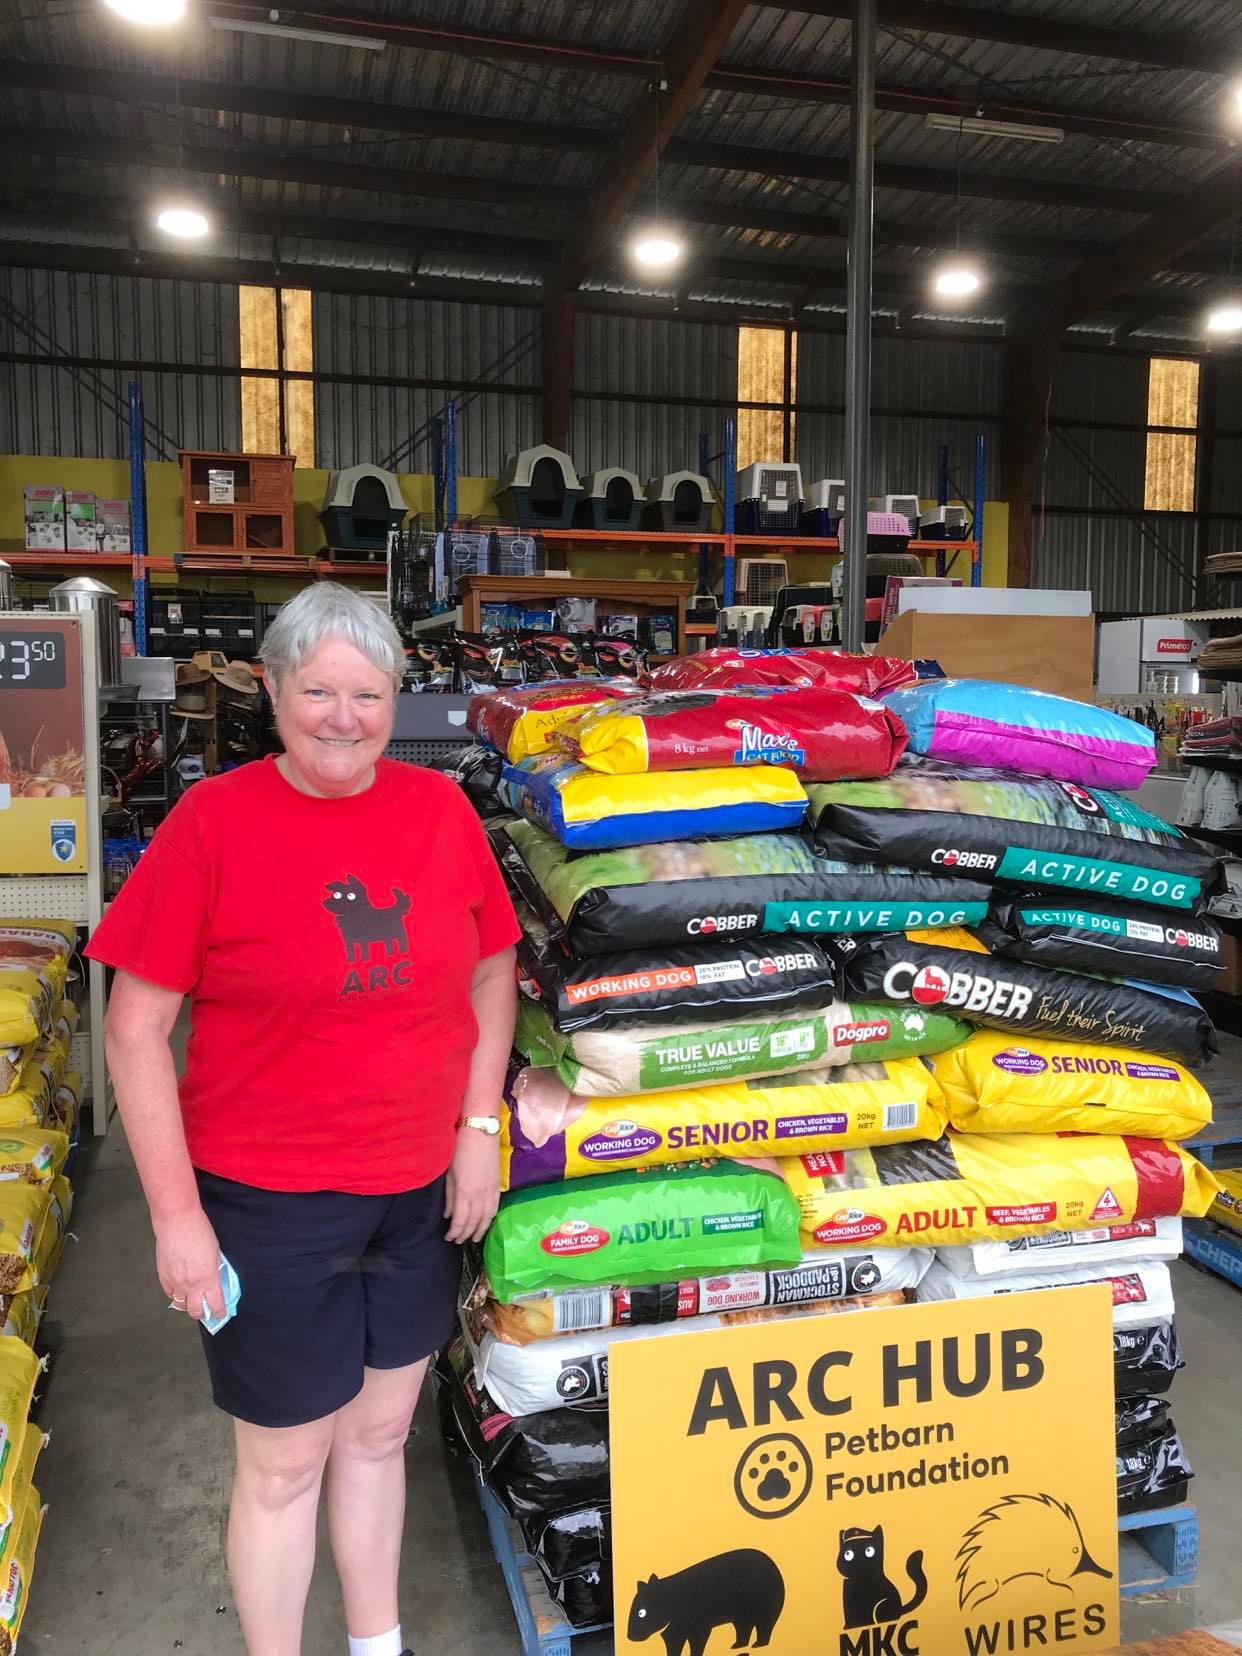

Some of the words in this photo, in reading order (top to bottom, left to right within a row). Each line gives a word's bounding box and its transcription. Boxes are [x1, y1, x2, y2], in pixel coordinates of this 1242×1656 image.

[742, 726, 798, 761] Max's
[1020, 859, 1122, 888] ACTIVE
[1132, 875, 1187, 901] DOG
[785, 911, 892, 927] ACTIVE
[905, 911, 965, 926] DOG
[1031, 912, 1085, 926] ACTIVE
[1091, 917, 1120, 932] DOG
[712, 964, 739, 972] PROTEIN
[341, 960, 412, 995] ARC
[572, 976, 651, 999] WORKING
[655, 971, 691, 985] DOG
[1036, 995, 1068, 1023] Fuel
[1067, 1006, 1101, 1029] their
[1102, 1010, 1146, 1041] Spirit
[837, 1025, 887, 1041] Dogpro
[655, 1045, 703, 1065] TRUE
[705, 1037, 761, 1058] VALUE
[660, 1064, 692, 1073] COMPLETE
[698, 1059, 728, 1068] BALANCED
[995, 1058, 1029, 1066] WORKING
[1051, 1056, 1124, 1076] SENIOR
[807, 1117, 845, 1126] VEGETABLES
[857, 1113, 876, 1121] 20kg
[858, 1122, 874, 1130] NET
[667, 1119, 770, 1149] SENIOR
[795, 1126, 817, 1134] BROWN
[584, 1139, 632, 1152] WORKING
[634, 1136, 656, 1146] DOG
[1011, 1206, 1050, 1214] VEGETABLES
[1066, 1201, 1084, 1209] 20kg
[720, 1223, 741, 1231] BROWN
[896, 1206, 978, 1235] ADULT
[617, 1217, 694, 1245] ADULT
[816, 1225, 860, 1238] WORKING
[861, 1223, 881, 1232] DOG
[550, 1237, 579, 1247] FAMILY
[580, 1235, 599, 1243] DOG
[777, 1268, 830, 1290] PADDOCK
[707, 1294, 723, 1306] DOG
[726, 1291, 760, 1304] WORKING
[777, 1282, 840, 1302] STOCKMAN
[1119, 1336, 1135, 1348] 18kg
[687, 1351, 854, 1436] ARC
[882, 1328, 1045, 1408] HUB
[825, 1421, 955, 1460] Petbarn
[826, 1452, 1009, 1501] Foundation
[839, 1620, 920, 1656] MKC
[964, 1603, 1107, 1655] WIRES
